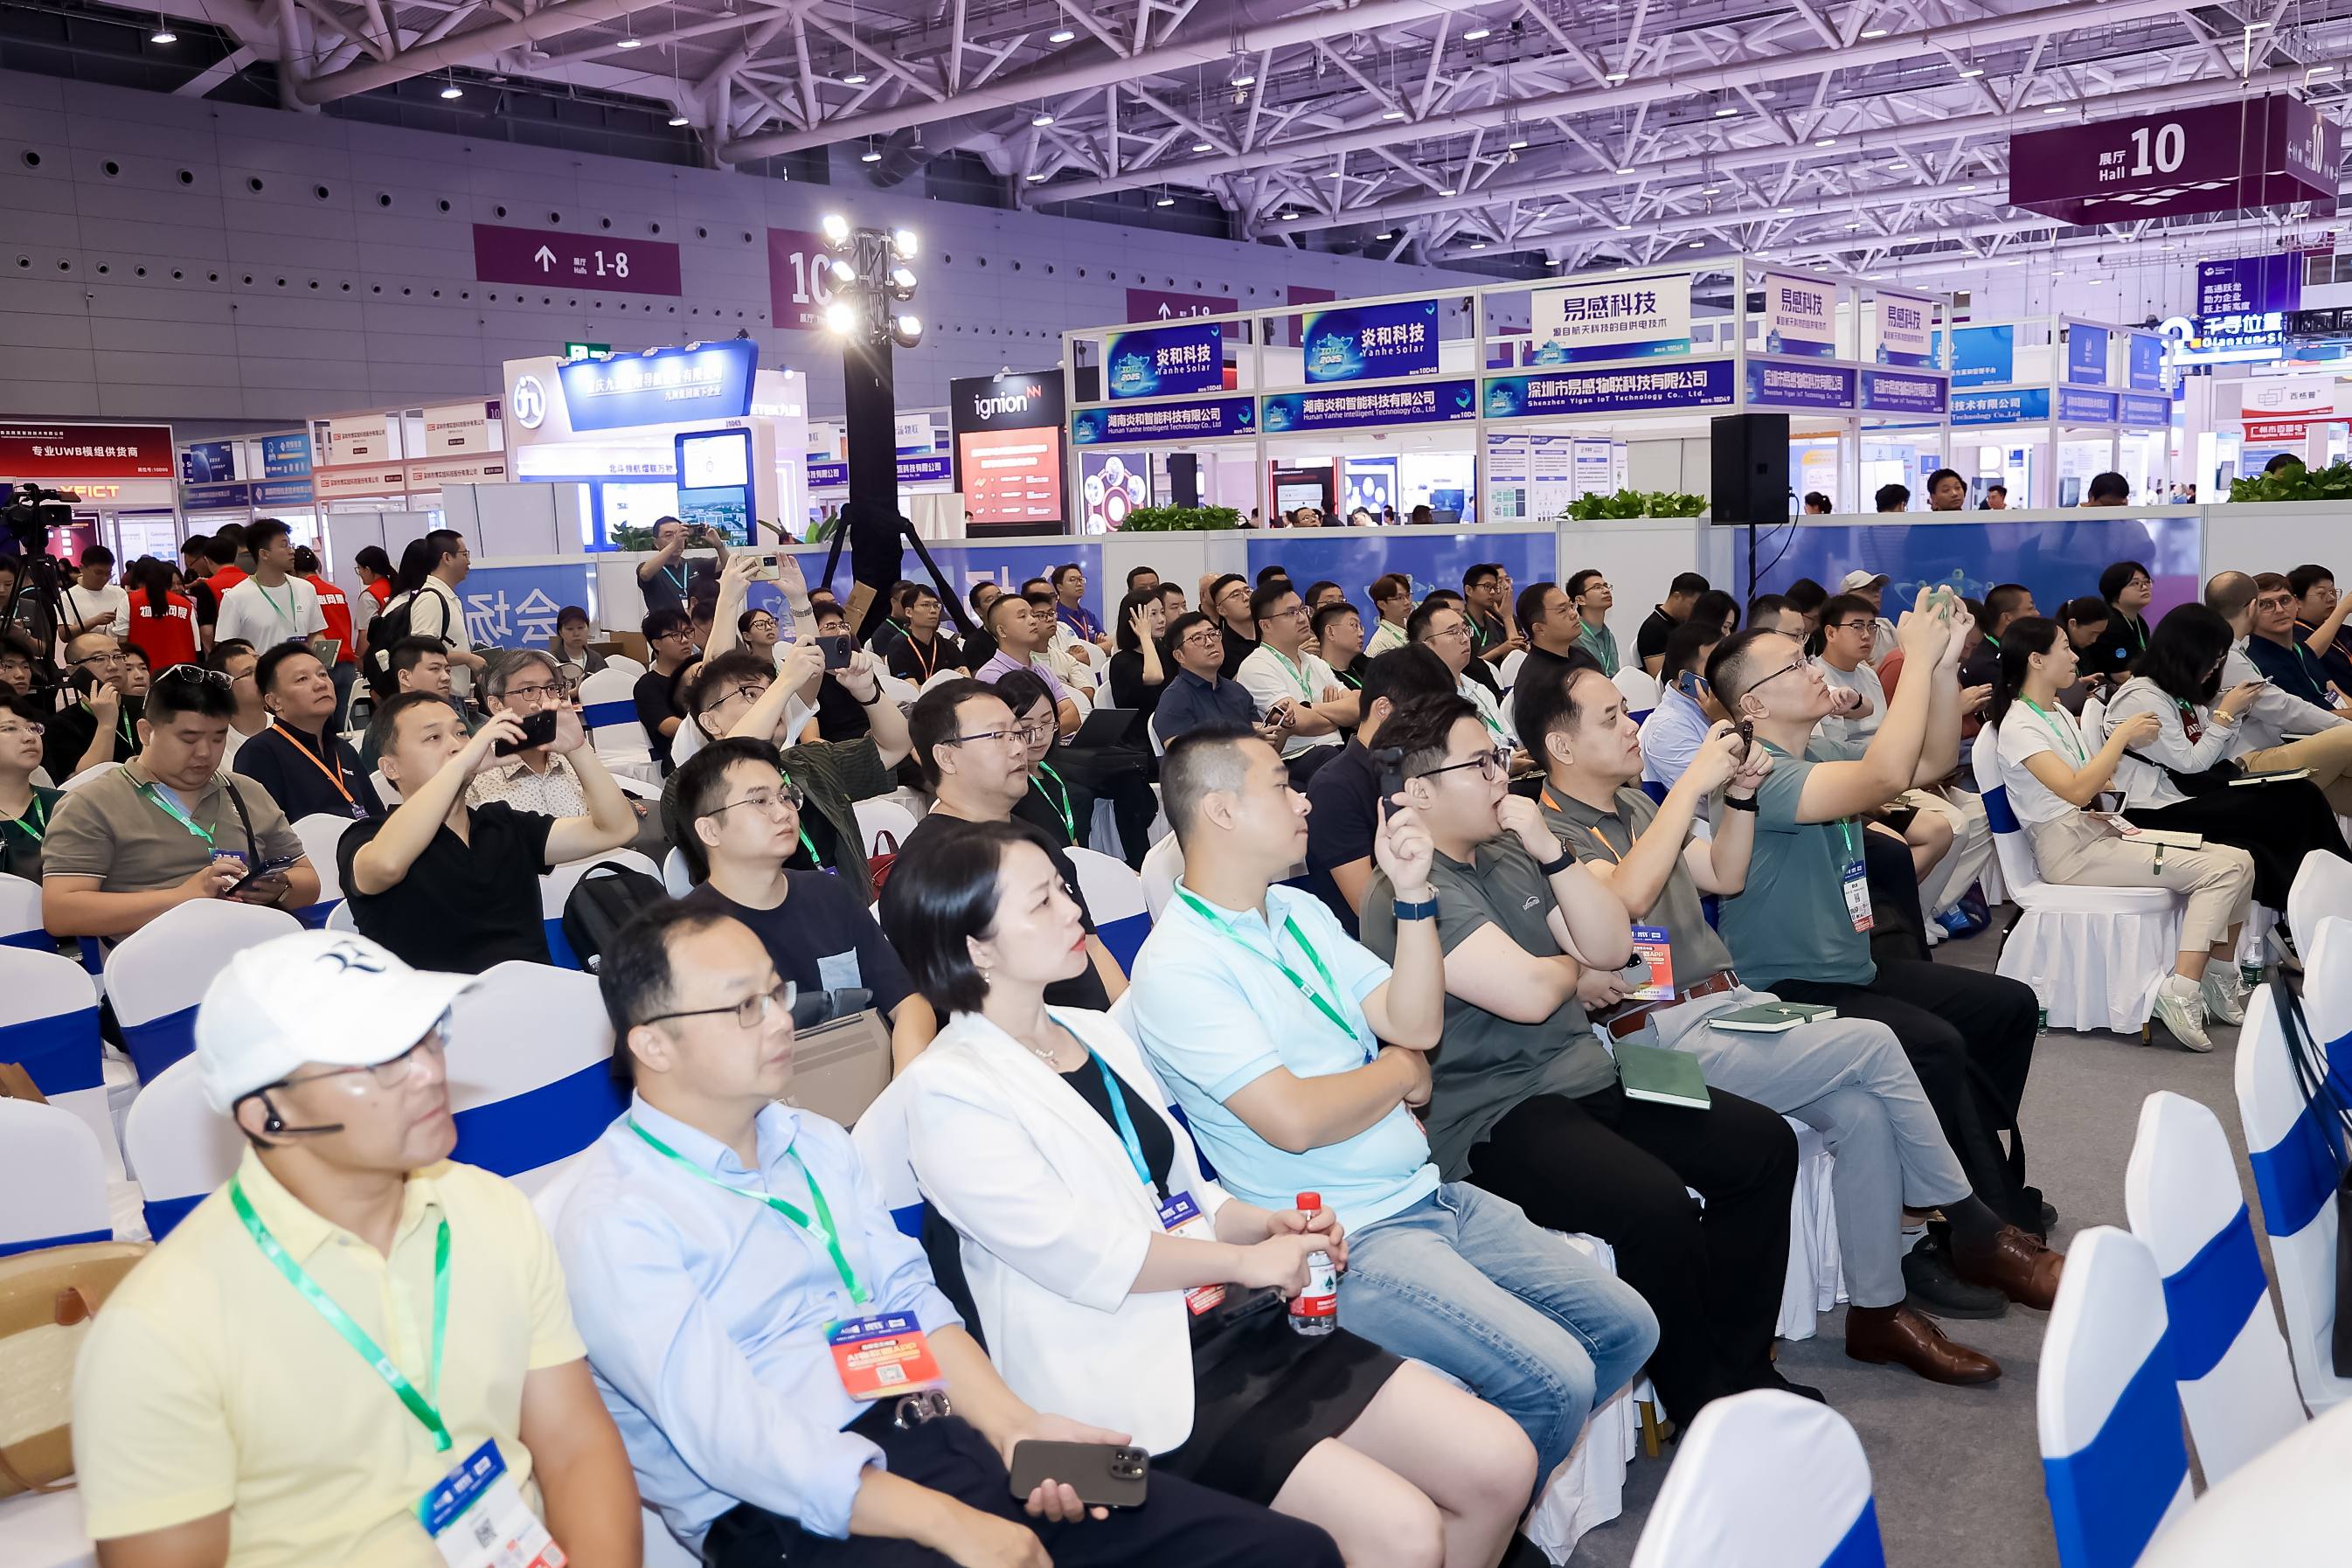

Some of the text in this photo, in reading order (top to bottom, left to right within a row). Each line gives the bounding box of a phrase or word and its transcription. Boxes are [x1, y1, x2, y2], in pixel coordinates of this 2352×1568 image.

[2099, 149, 2126, 166] 展厅
[2130, 122, 2186, 177] 10
[2312, 124, 2324, 174] 10
[2099, 166, 2126, 182] Hall
[594, 250, 629, 278] 1-8
[1564, 291, 1656, 322] 易感科技
[1782, 288, 1822, 316] 易感科技
[2203, 292, 2242, 304] 助力企业
[1552, 318, 1668, 337] 源自航天科技的自供电技术
[1888, 306, 1921, 330] 易感科技
[1361, 322, 1426, 348] 炎和科技
[1156, 343, 1211, 366] 炎和科技
[1319, 355, 1343, 364] 2025
[1362, 344, 1424, 357] Yanhe Solar
[1157, 364, 1211, 376] Yanhe Solar
[1528, 371, 1707, 399] 深圳市易感物联科技有限公司
[974, 391, 1028, 420] ignion
[1302, 390, 1435, 414] 湖南炎和智能科技有限公司
[1528, 399, 1566, 407] Shenzhen
[1597, 395, 1610, 404] IoT
[1615, 392, 1662, 403] Technology
[1107, 407, 1221, 427] 湖南炎和智能科技有限公司
[1324, 411, 1343, 420] Yanhe
[1344, 409, 1374, 420] Intelligent
[1376, 407, 1411, 418] Technology
[1143, 423, 1169, 434] Intelligent
[1169, 421, 1201, 431] Technology
[31, 446, 139, 458] 专业UWB模组供货商
